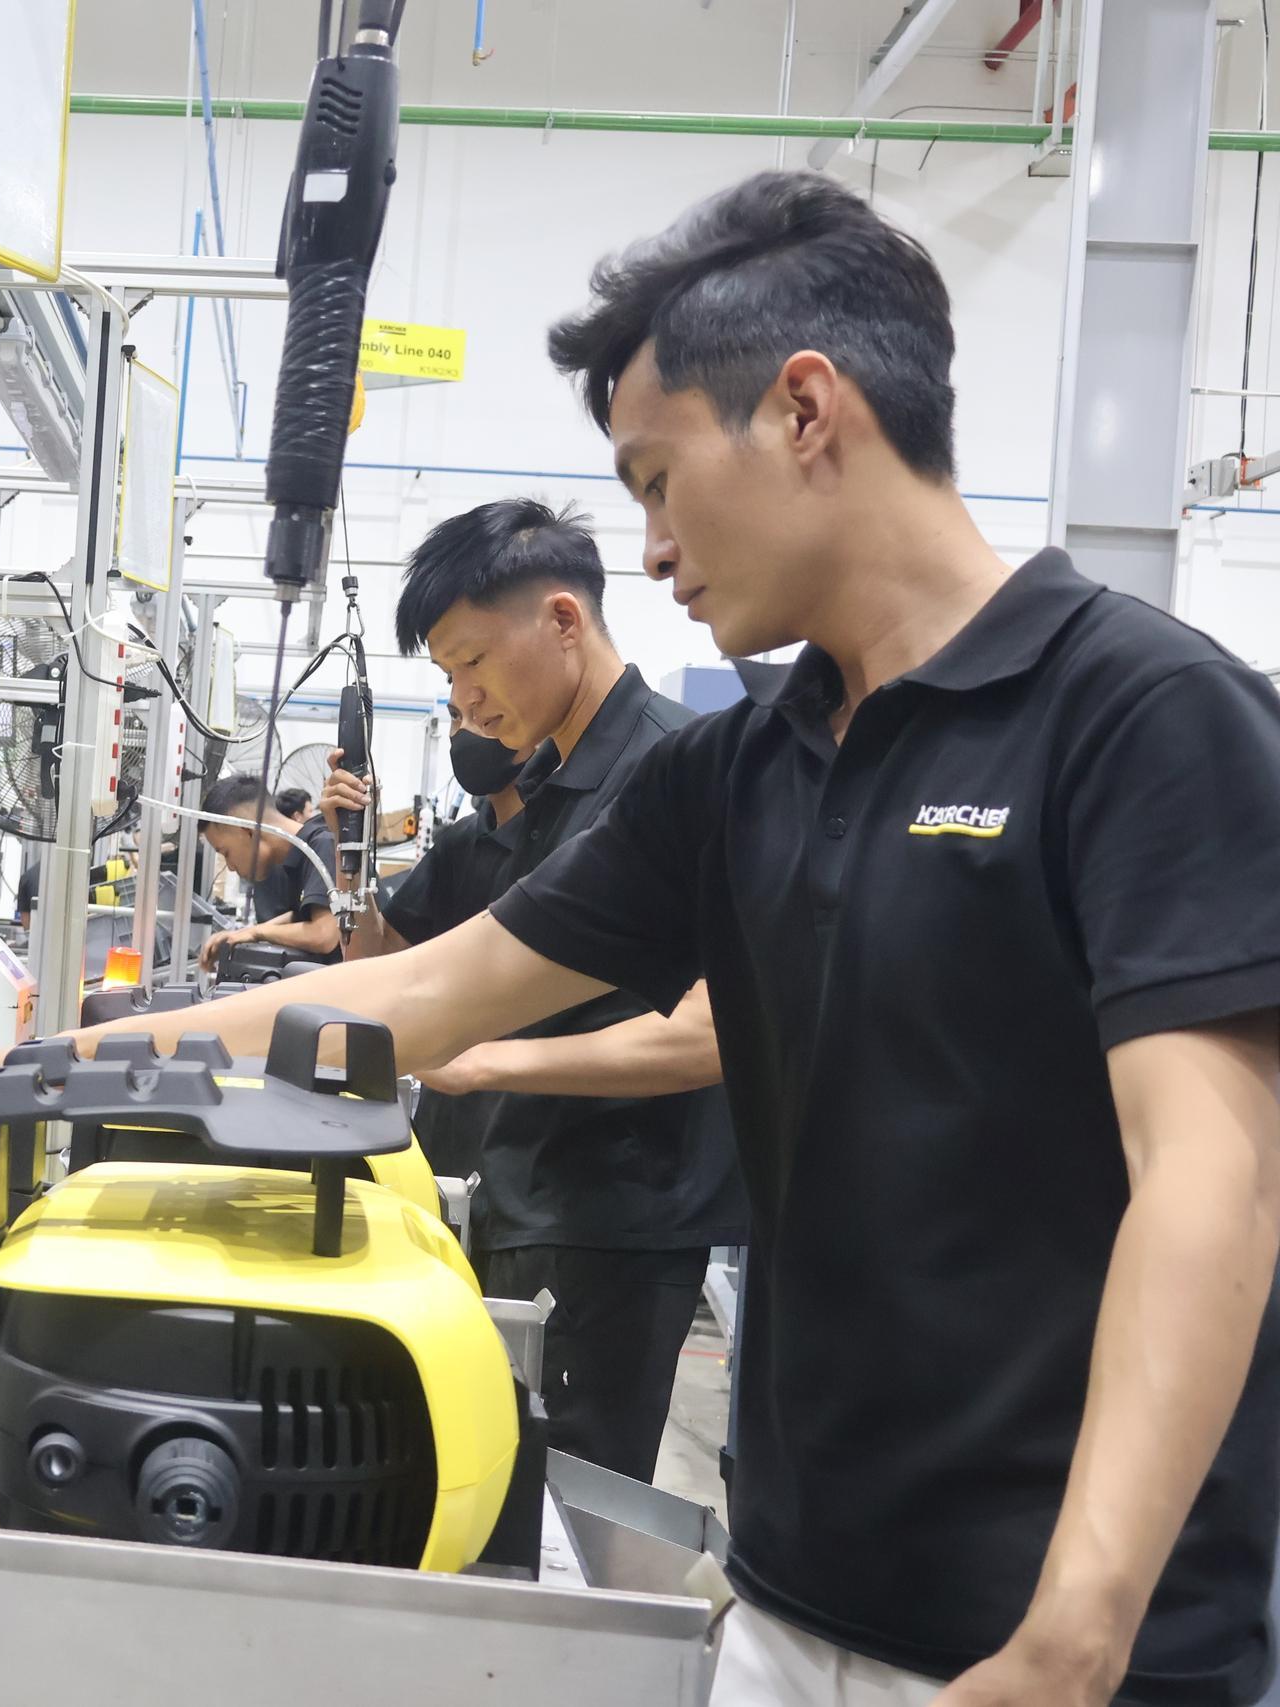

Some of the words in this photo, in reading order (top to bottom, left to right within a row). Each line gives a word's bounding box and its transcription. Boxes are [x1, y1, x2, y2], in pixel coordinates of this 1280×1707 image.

[360, 342, 391, 355] mbly
[395, 344, 424, 358] Line
[428, 347, 451, 360] 040
